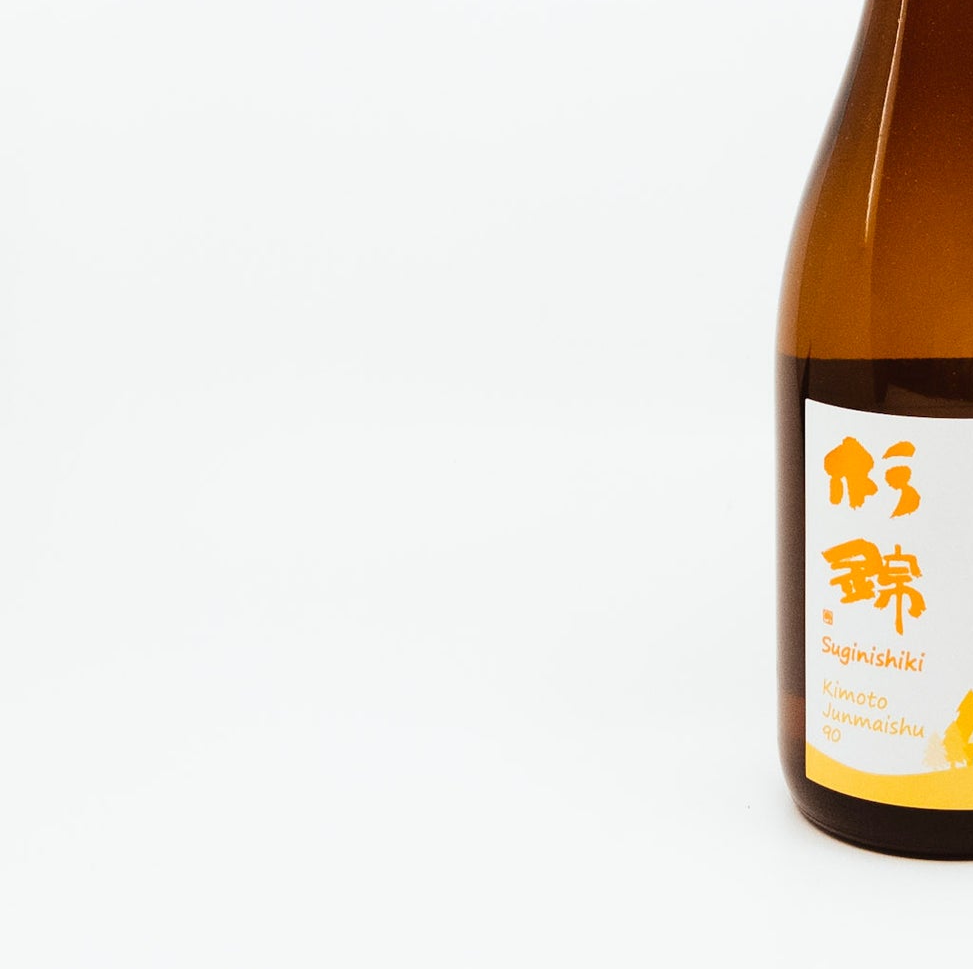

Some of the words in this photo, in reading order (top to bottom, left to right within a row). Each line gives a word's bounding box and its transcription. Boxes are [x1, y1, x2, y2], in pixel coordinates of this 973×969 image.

[822, 636, 925, 672] Suginishiki
[823, 678, 888, 709] Kimoto
[822, 702, 925, 738] Junmaishu
[822, 725, 842, 743] 90
